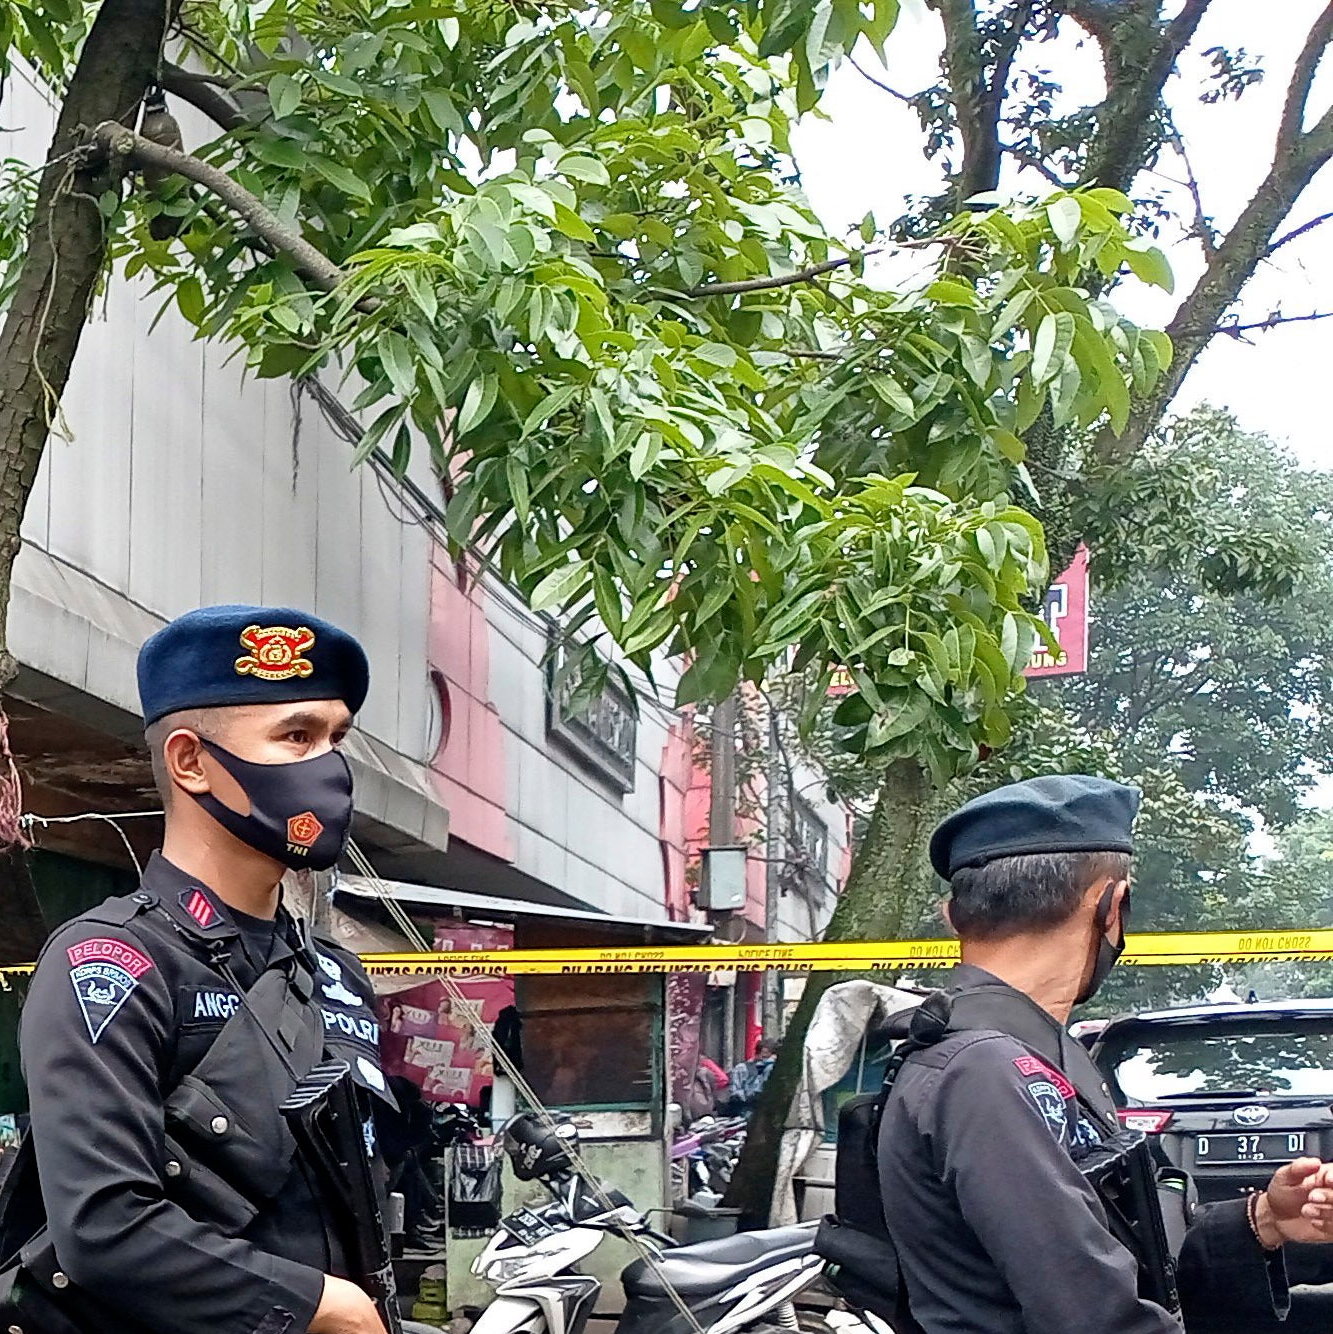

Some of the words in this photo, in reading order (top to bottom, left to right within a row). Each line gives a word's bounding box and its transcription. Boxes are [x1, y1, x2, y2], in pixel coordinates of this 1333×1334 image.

[1030, 651, 1068, 669] UNG
[286, 843, 309, 857] TNI
[73, 941, 143, 972] PELOPOR
[320, 1008, 379, 1046] POLRI
[1198, 1137, 1209, 1155] D
[1237, 1135, 1260, 1153] 37
